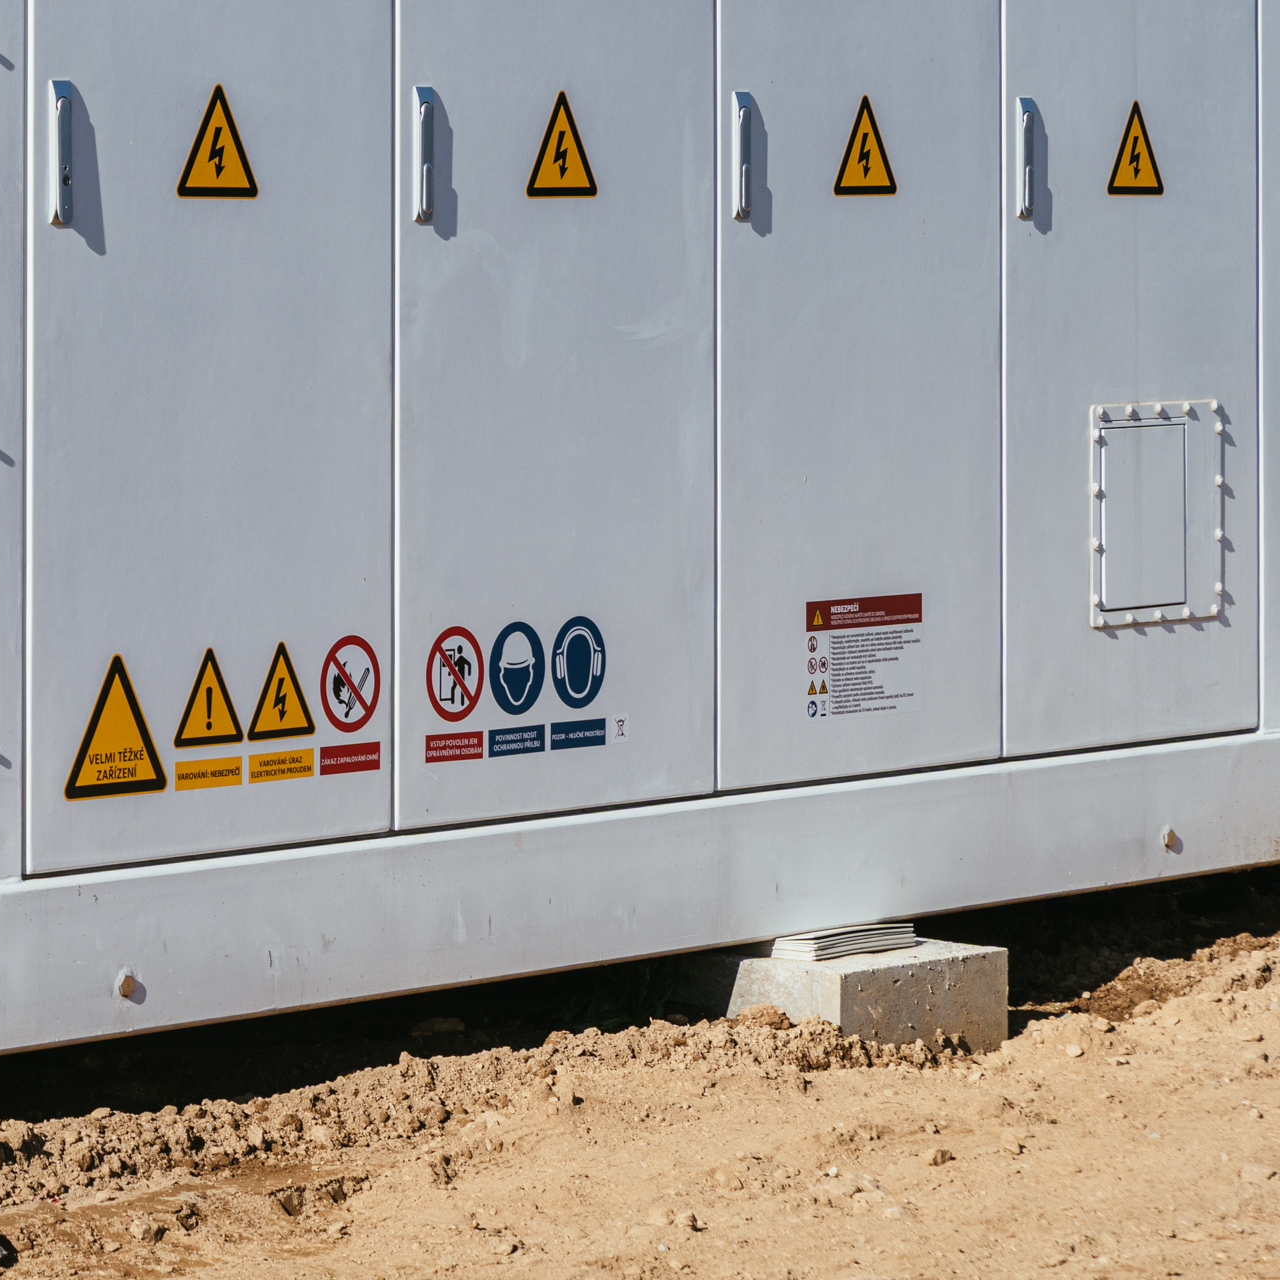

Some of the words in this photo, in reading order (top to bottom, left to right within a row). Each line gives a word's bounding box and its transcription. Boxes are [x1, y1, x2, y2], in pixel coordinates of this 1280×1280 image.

[88, 752, 116, 765] VELMI
[118, 746, 144, 763] TĚŽKÉ
[96, 763, 137, 781] ZAŘÍZENÍ
